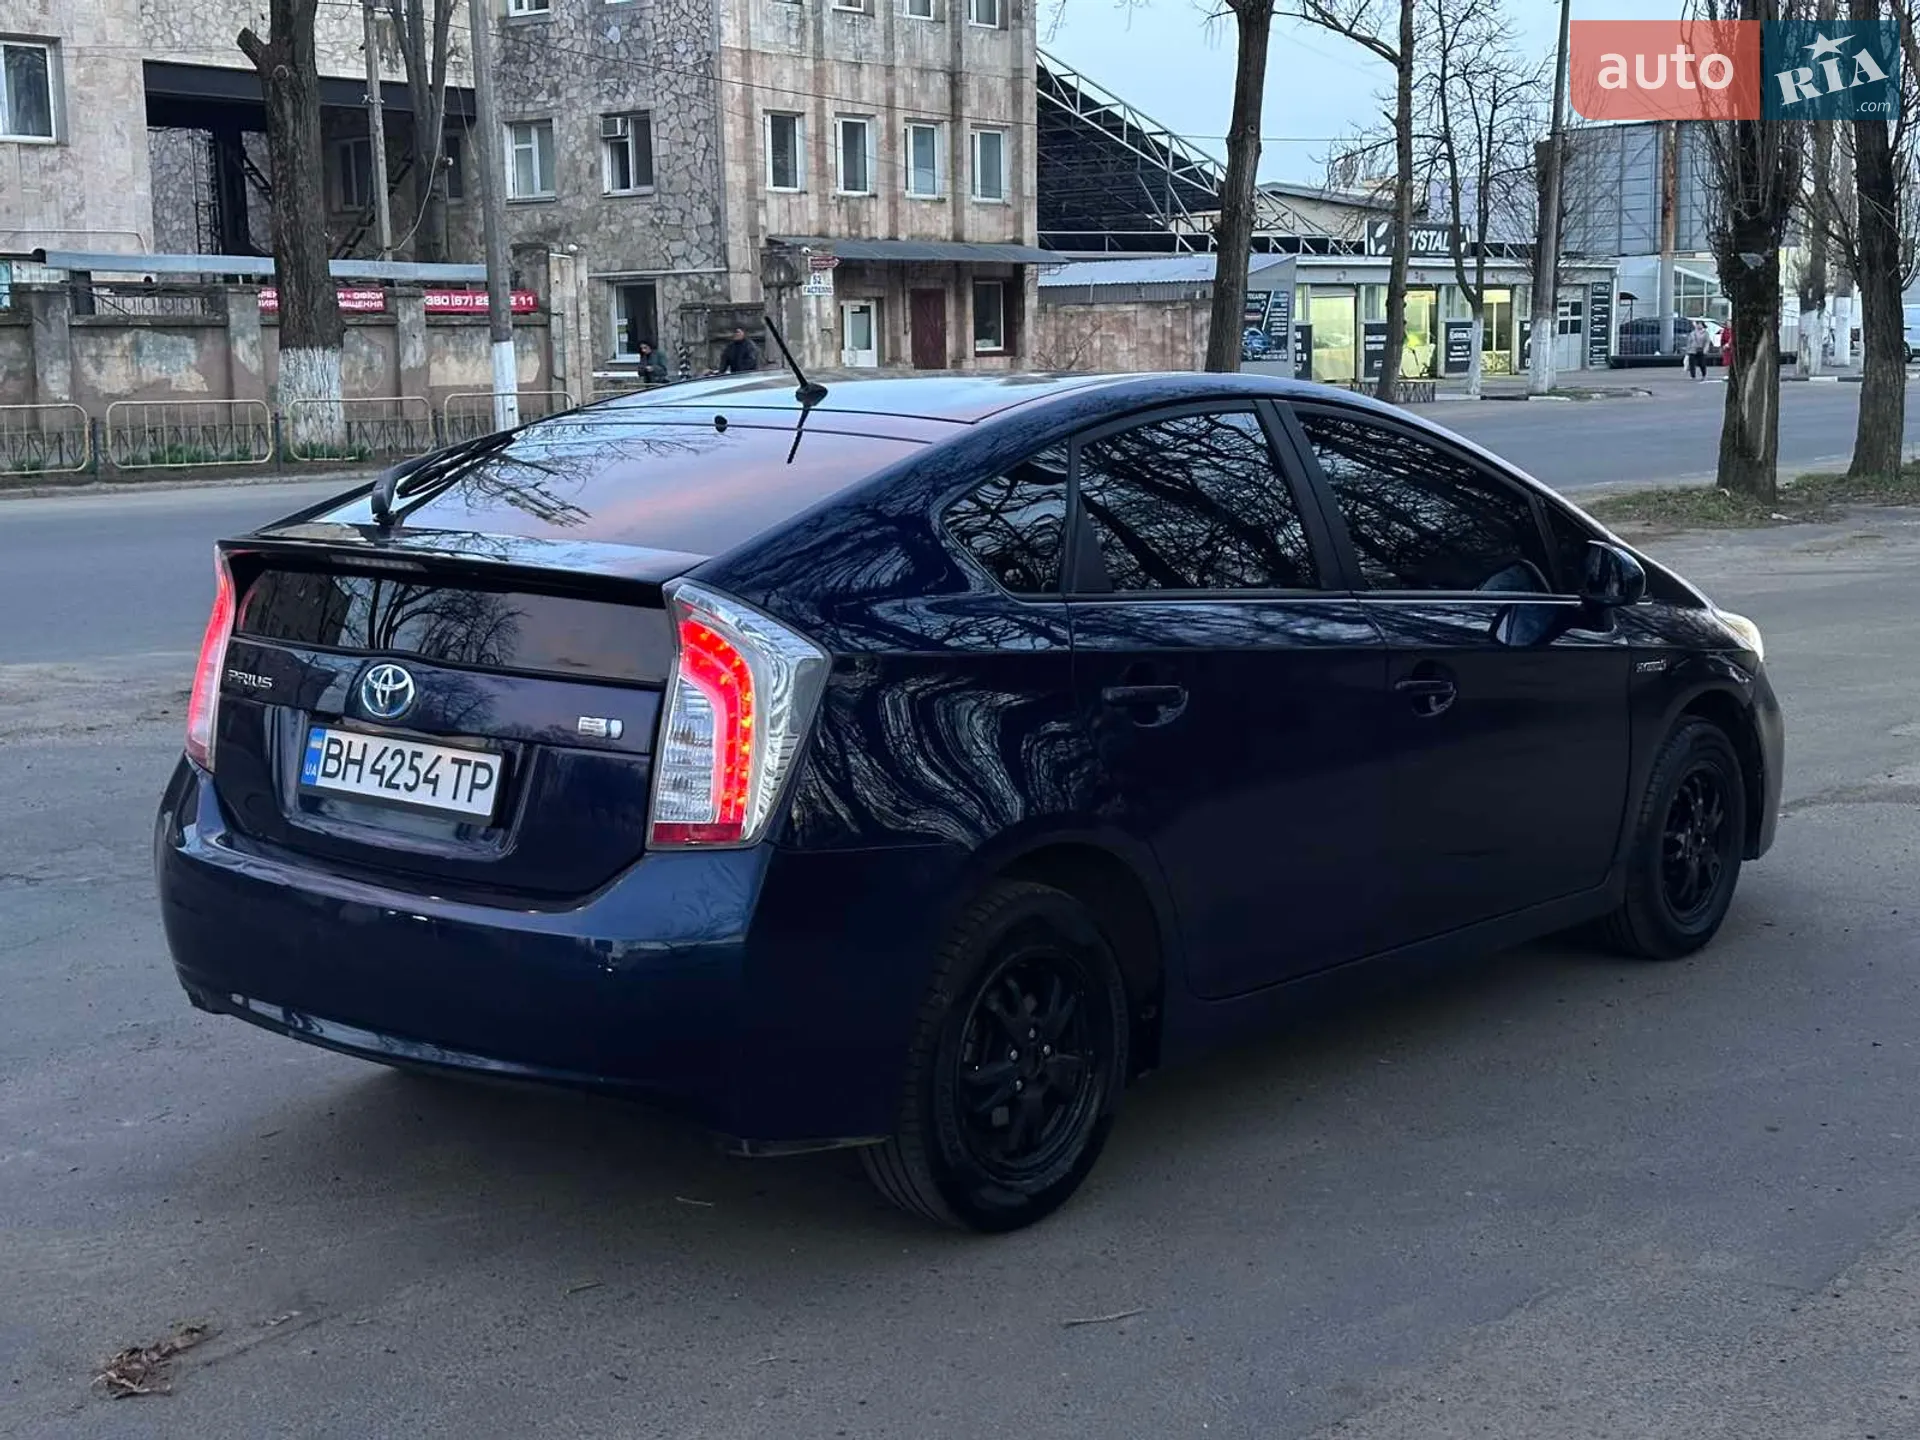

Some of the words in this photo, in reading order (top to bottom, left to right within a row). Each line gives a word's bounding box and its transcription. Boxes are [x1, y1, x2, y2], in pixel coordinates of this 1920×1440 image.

[1392, 229, 1450, 252] YSTAL
[338, 300, 383, 308] МІЩЕННЯ
[227, 669, 273, 688] PRIUS
[305, 763, 317, 776] UA
[320, 737, 367, 783] BH
[370, 746, 442, 797] 4254
[450, 757, 494, 803] TP
